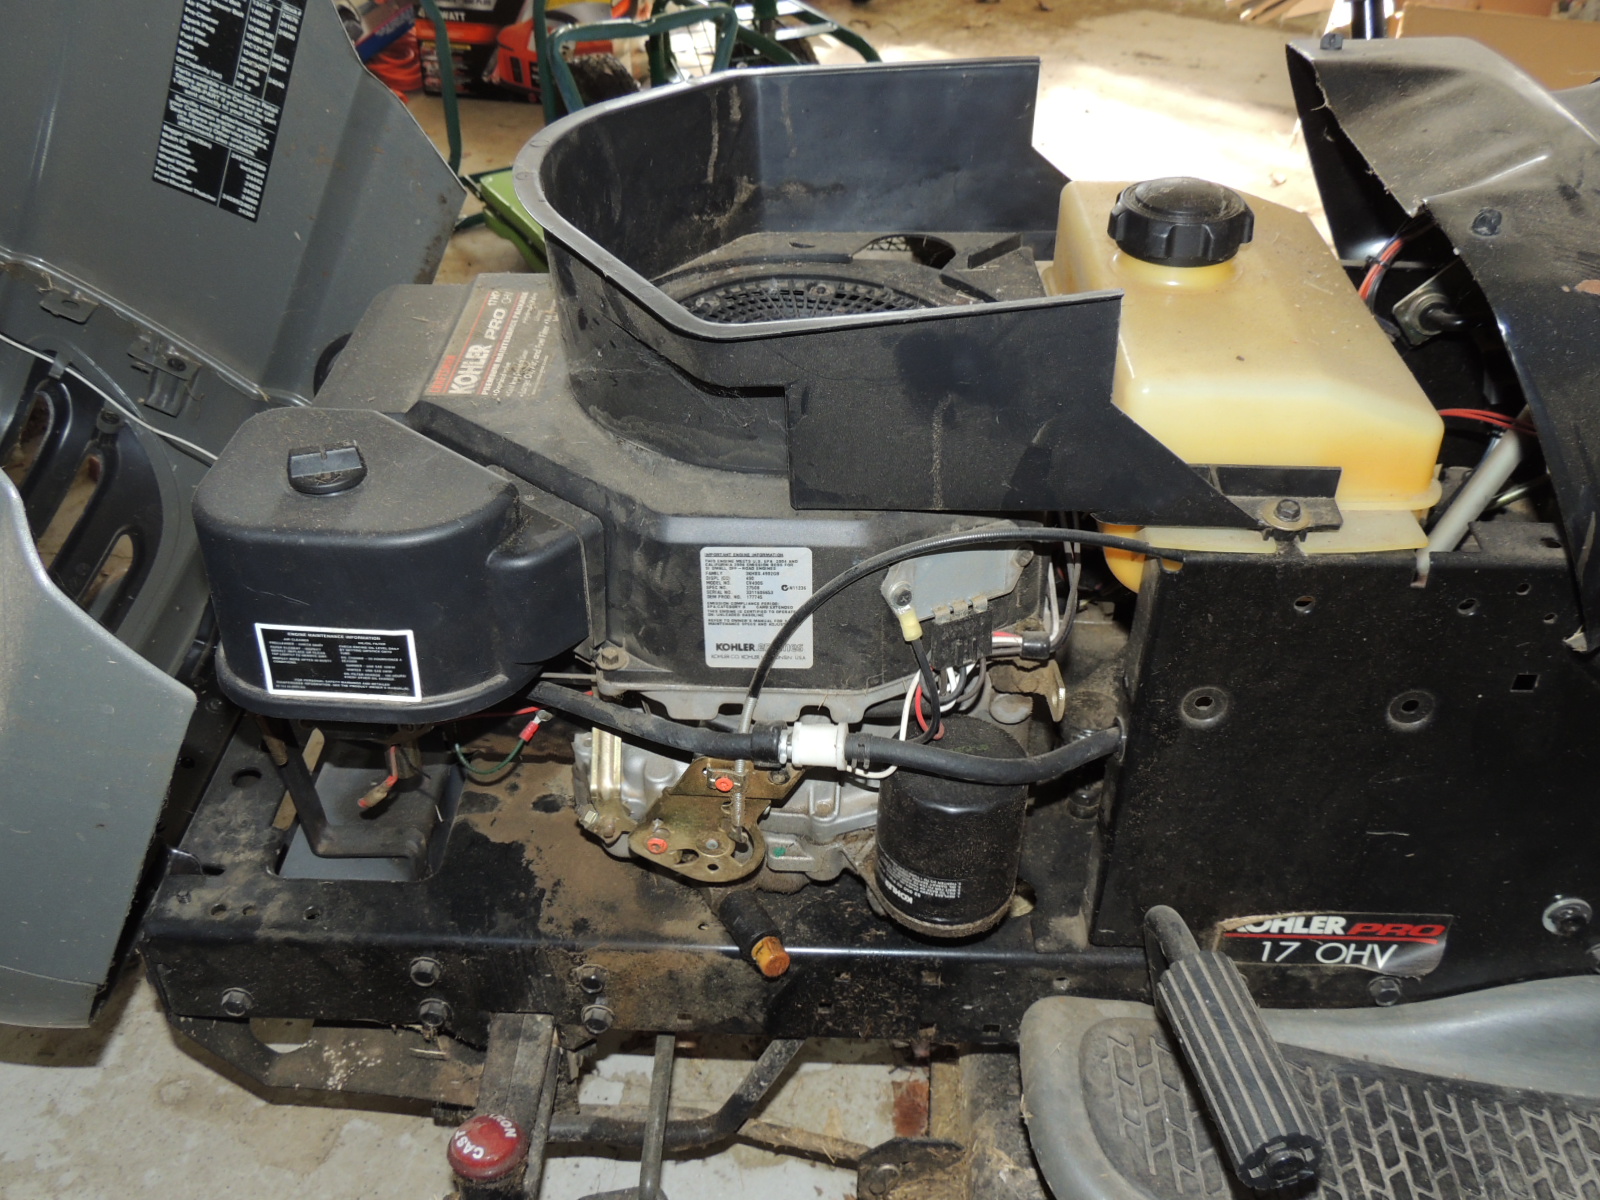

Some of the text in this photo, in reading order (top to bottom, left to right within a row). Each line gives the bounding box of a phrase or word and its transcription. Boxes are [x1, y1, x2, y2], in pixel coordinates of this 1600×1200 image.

[447, 308, 508, 393] KOHLER PRO
[480, 363, 501, 394] PREMIUM
[716, 643, 804, 652] KOHLER ennes
[884, 878, 913, 904] KOHLER
[1348, 922, 1445, 937] PRO
[1261, 940, 1398, 969] 17 OHV
[454, 1130, 484, 1160] CAST
